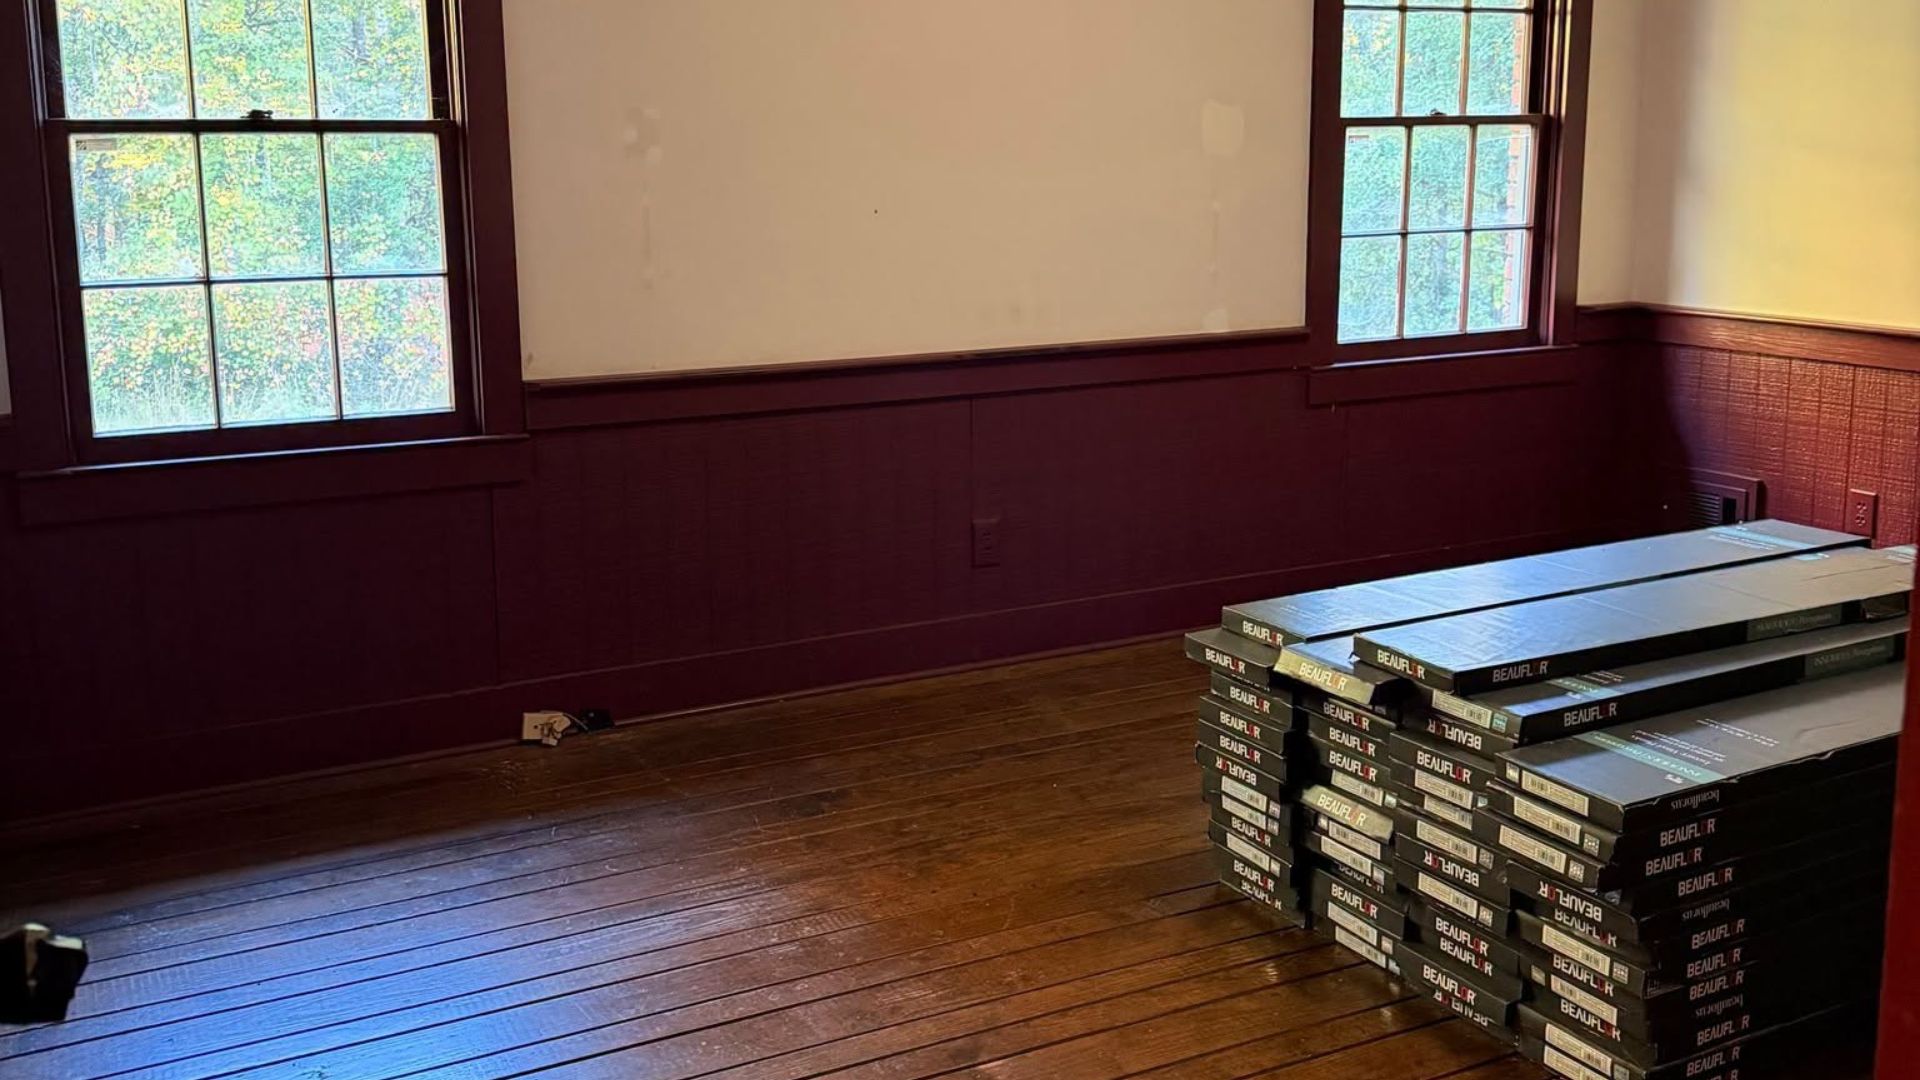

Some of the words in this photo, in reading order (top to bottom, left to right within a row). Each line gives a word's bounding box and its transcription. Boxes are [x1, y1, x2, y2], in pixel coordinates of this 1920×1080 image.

[1242, 621, 1284, 646] BEAUFLOR
[1205, 648, 1246, 674] BEAUFLOR
[1299, 663, 1347, 690] BEAUFLOR
[1377, 650, 1426, 680] BEAUFLOR
[1230, 686, 1270, 714] BEAUFLOR
[1564, 702, 1617, 727] BEAUFLOR
[1220, 712, 1261, 739] BEAUFLOR
[1323, 702, 1370, 732] BEAUFLOR
[1220, 735, 1261, 764] BEAUFLOR
[1329, 727, 1376, 757] BEAUFLOR
[1427, 718, 1482, 750] BEAUFLOR
[1215, 756, 1257, 786] BEAUFLOR
[1329, 751, 1378, 782] BEAUFLOR
[1416, 750, 1472, 784] BEAUFLOR
[1317, 794, 1366, 826] BEAUFLOR
[1231, 817, 1271, 847] BEAUFLOR
[1234, 859, 1275, 892] BEAUFLOR
[1424, 850, 1480, 888] BEAUFLOR
[1331, 883, 1378, 919] BEAUFLOR
[1539, 881, 1602, 922] BEAUFLOR
[1435, 916, 1490, 957] BEAUFLOR
[1440, 937, 1492, 977] BEAUFLOR
[1423, 964, 1477, 1006] BEAUFLOR
[1553, 953, 1615, 997] BEAUFLOR
[1697, 1015, 1750, 1046] BEAUFLR
[1686, 1046, 1741, 1077] BEAUFLR
